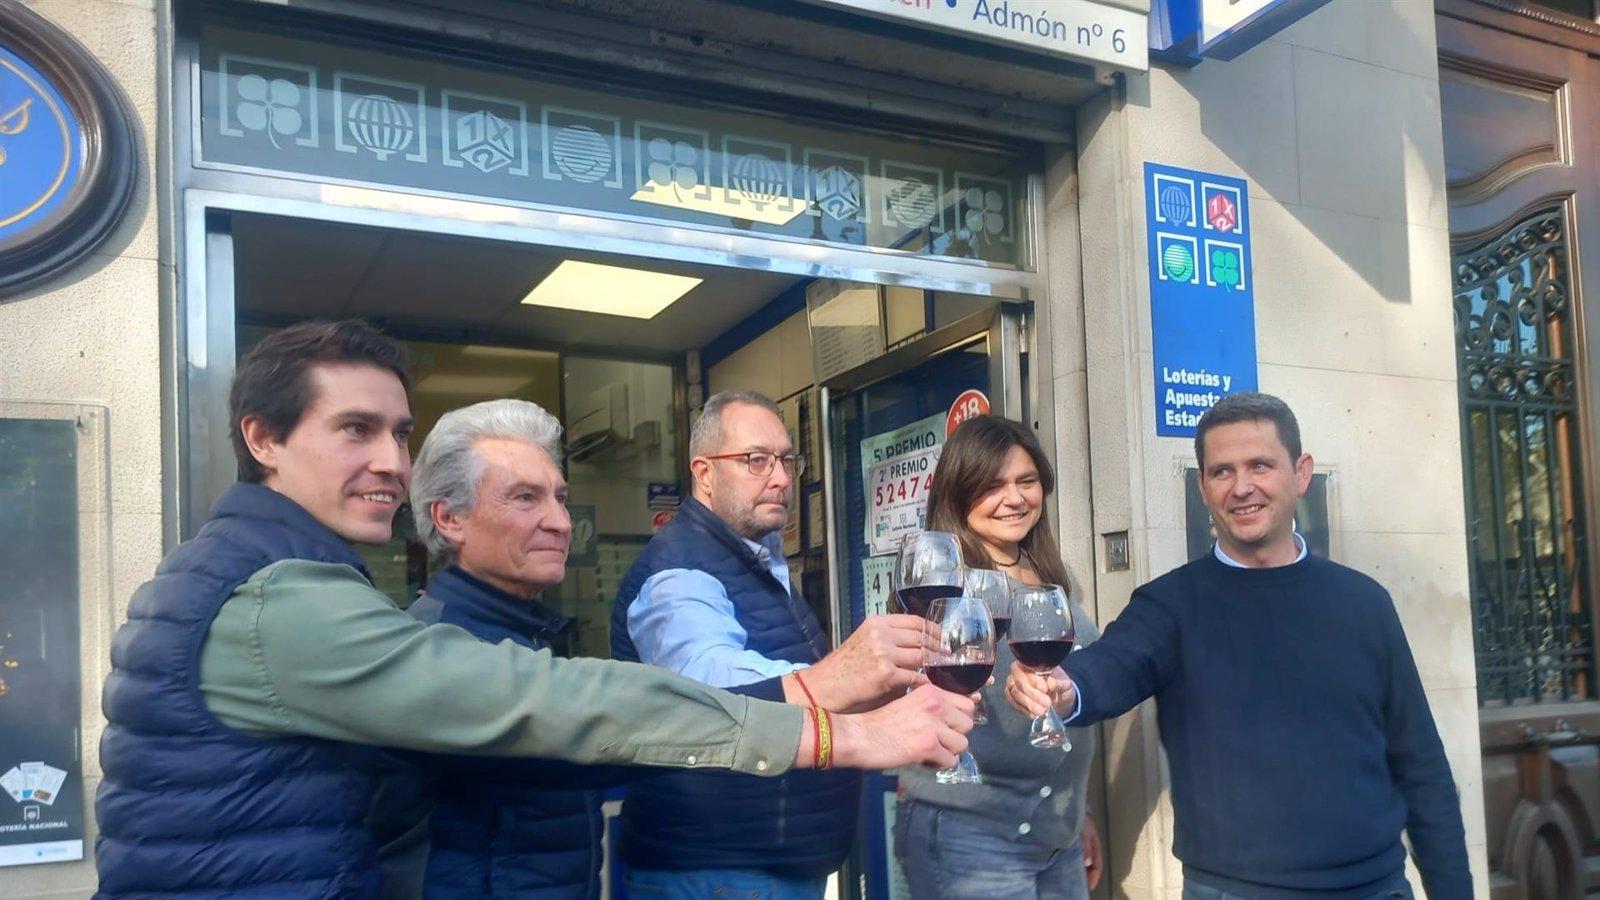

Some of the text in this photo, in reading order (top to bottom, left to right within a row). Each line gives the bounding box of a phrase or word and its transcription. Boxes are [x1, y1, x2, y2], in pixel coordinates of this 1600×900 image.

[973, 0, 1126, 54] Admón nº 6
[1163, 366, 1231, 392] Loterías y
[954, 396, 981, 425] +18
[1165, 388, 1221, 409] Apuesta
[886, 431, 936, 460] PREMIO
[890, 457, 928, 479] PREMIO
[876, 472, 935, 507] 52474
